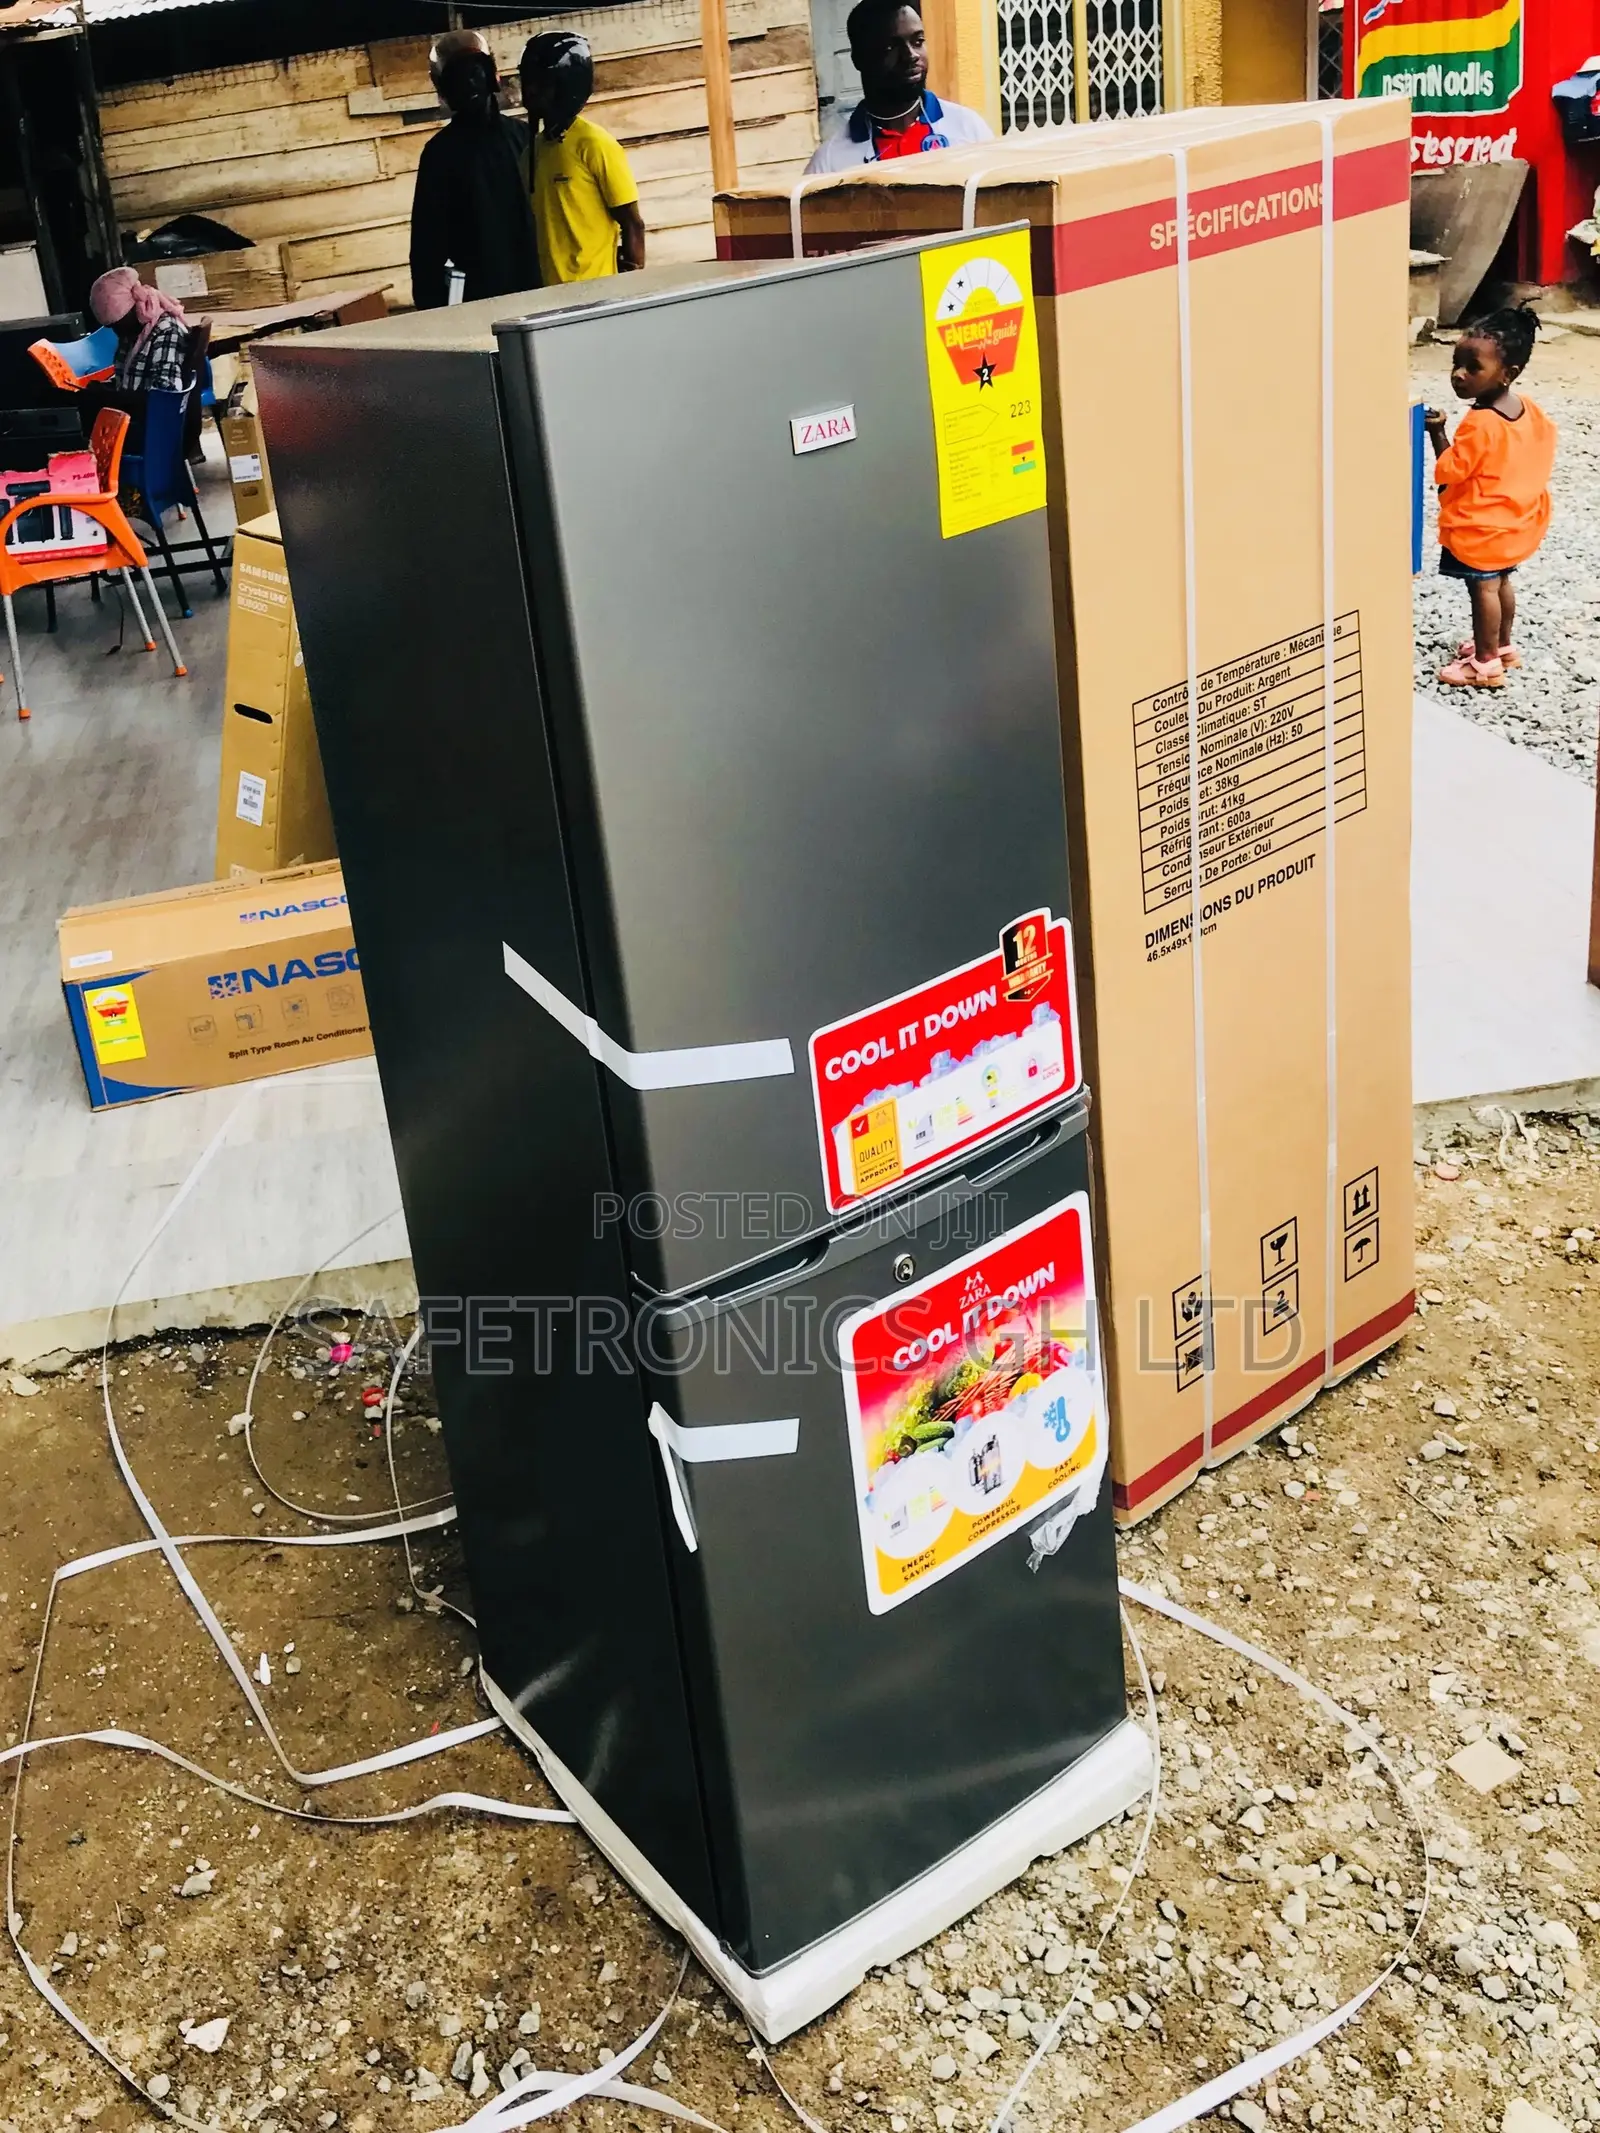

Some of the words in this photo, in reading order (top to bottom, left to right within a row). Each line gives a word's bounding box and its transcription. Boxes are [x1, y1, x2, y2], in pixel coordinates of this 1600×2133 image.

[945, 319, 993, 348] ENERGY
[993, 320, 1017, 345] guide
[982, 368, 989, 381] 2
[1010, 400, 1032, 418] 223
[801, 416, 851, 444] ZARA
[240, 563, 289, 585] SAMSUNG
[1152, 686, 1198, 713] Contrô
[1201, 678, 1214, 693] de
[1216, 650, 1281, 686] Température
[1289, 624, 1342, 655] Mécanie
[1155, 711, 1192, 734] Couleu
[1198, 700, 1214, 715] Du
[1216, 683, 1255, 708] Produit:
[1258, 666, 1291, 691] Argent
[1156, 732, 1190, 755] Classe
[1253, 696, 1268, 711] ST
[1156, 754, 1192, 776] Tensio
[1200, 724, 1248, 757] Nominale
[1250, 718, 1268, 739] (V):
[1270, 705, 1295, 726] 220V
[1157, 762, 1213, 797] Fréquce
[1215, 740, 1264, 771] Nominale
[1266, 732, 1289, 751] (Hz):
[1291, 724, 1303, 738] 50
[1159, 796, 1189, 818] Poids
[1197, 786, 1213, 801] et:
[1215, 773, 1240, 793] 38kg
[1160, 817, 1190, 838] Poids
[1198, 804, 1218, 821] rut:
[1221, 792, 1245, 810] 41kg
[1160, 822, 1220, 857] Réfrigrant
[1227, 810, 1251, 829] 600a
[1162, 838, 1226, 877] Condnseur
[1228, 816, 1275, 846] Extérieur
[1164, 875, 1202, 899] Serru
[1205, 865, 1218, 880] De
[1221, 850, 1251, 874] Porte:
[1254, 839, 1272, 856] Oui
[1236, 884, 1254, 904] DU
[1258, 853, 1316, 894] PRODUIT
[1012, 925, 1036, 959] 12
[229, 1049, 249, 1060] Split
[250, 1044, 272, 1056] Type
[274, 1038, 300, 1049] Room
[302, 1036, 314, 1044] Air
[316, 1026, 366, 1041] Conditioner
[825, 1036, 895, 1081] COOL
[898, 1021, 919, 1051] IT
[924, 985, 997, 1039] DOWN
[860, 1137, 894, 1163] QUALITY
[860, 1162, 900, 1183] APPROVED
[959, 1283, 992, 1310] ZARA
[893, 1322, 959, 1370] COOL
[962, 1303, 984, 1334] IT
[986, 1261, 1056, 1320] DOWN
[1047, 1462, 1081, 1489] COOLING
[1054, 1457, 1074, 1475] FAST
[967, 1504, 1022, 1542] COMPRESSOR
[972, 1497, 1016, 1529] POWERFUL
[901, 1548, 936, 1573] ENERGY
[904, 1559, 937, 1582] SAVING
